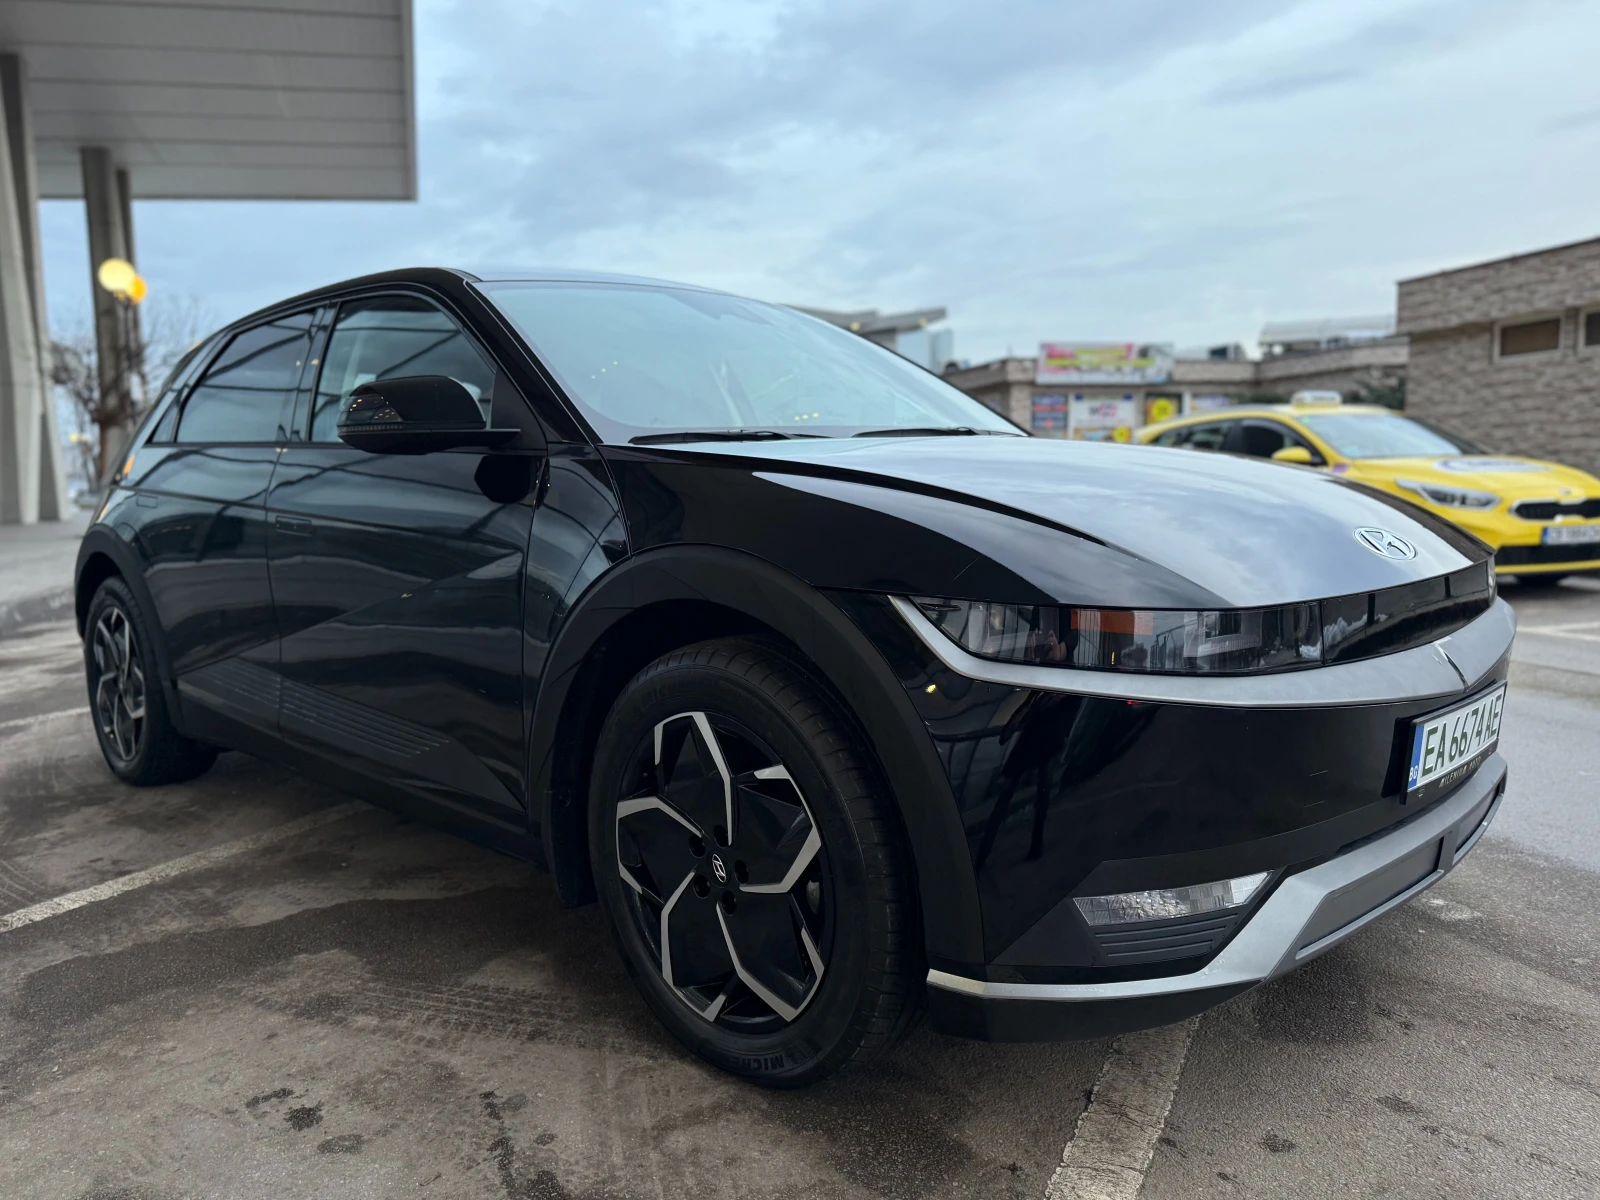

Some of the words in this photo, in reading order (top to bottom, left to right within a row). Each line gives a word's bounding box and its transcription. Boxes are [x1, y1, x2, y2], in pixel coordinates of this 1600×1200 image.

[1421, 722, 1447, 777] EA
[1449, 703, 1486, 762] 6674
[1483, 693, 1502, 743] AE
[1408, 766, 1419, 782] BG
